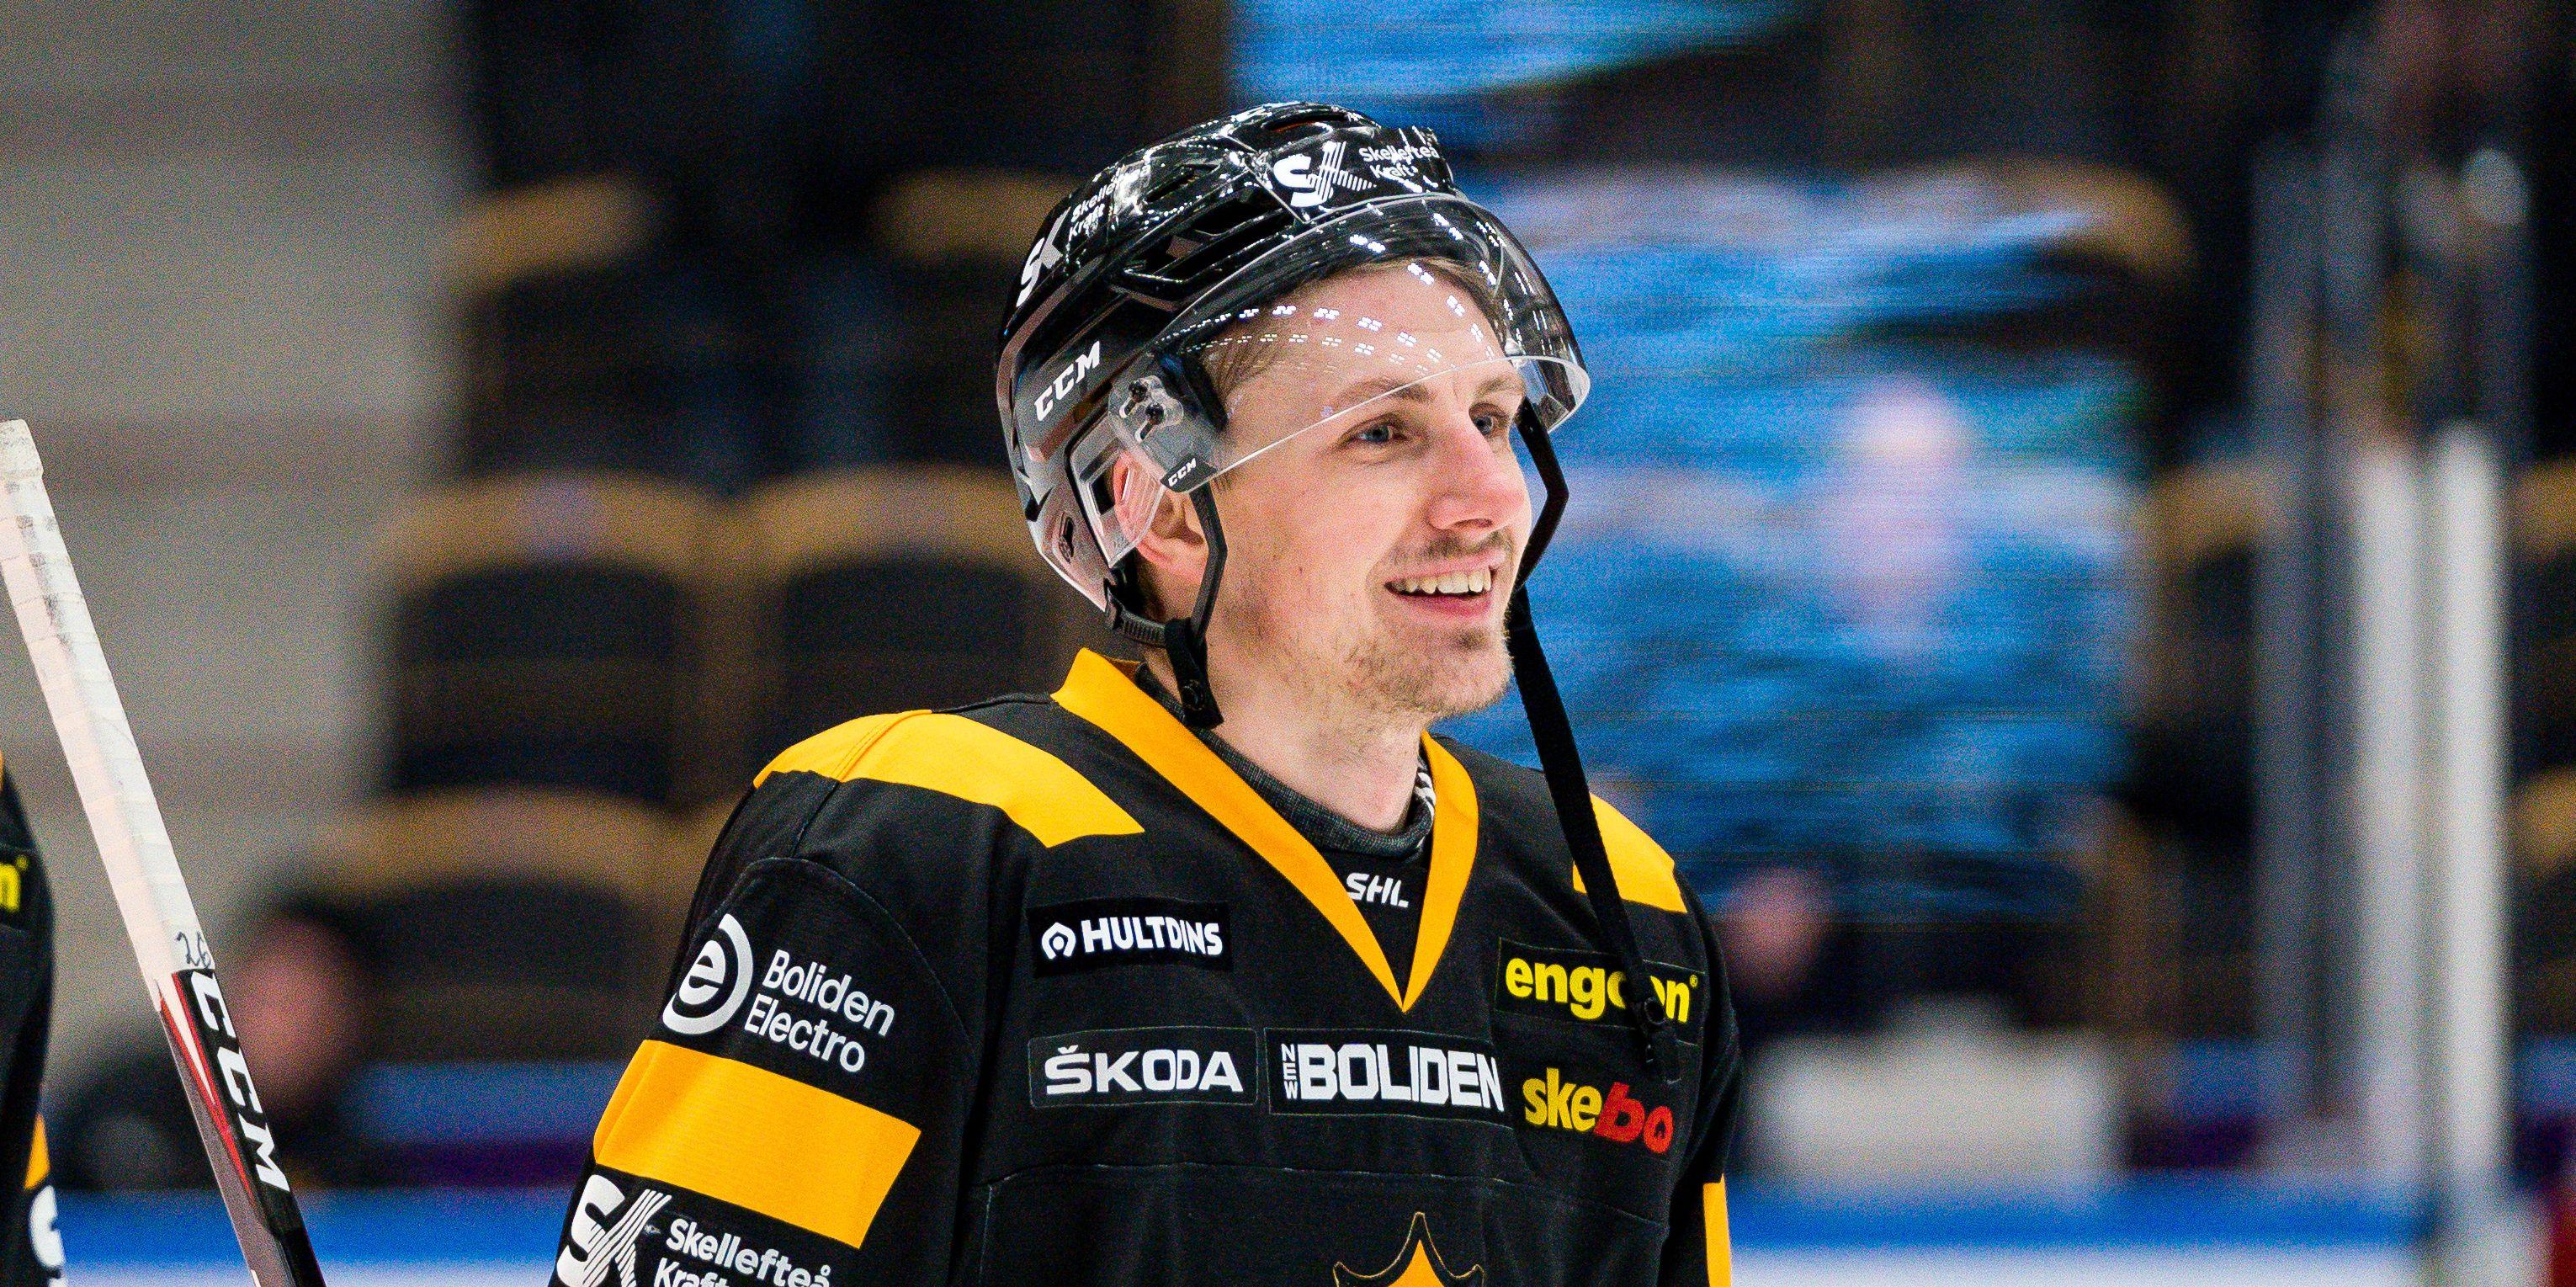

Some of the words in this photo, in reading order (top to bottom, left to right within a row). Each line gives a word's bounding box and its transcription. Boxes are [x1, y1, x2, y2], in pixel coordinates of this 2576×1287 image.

[1034, 340, 1100, 421] CCM
[1167, 457, 1197, 487] CCM
[1346, 872, 1409, 908] SHL
[1081, 916, 1224, 955] HULTDINS
[762, 949, 895, 1038] Boliden
[744, 995, 865, 1073] Electro
[191, 971, 290, 1192] CCM
[1044, 1045, 1244, 1095] ŠKODA
[1281, 1043, 1298, 1100] NEW
[1297, 1044, 1505, 1112] BOLIDEN
[1522, 1066, 1674, 1154] skebo
[667, 1218, 831, 1287] Skellefteå
